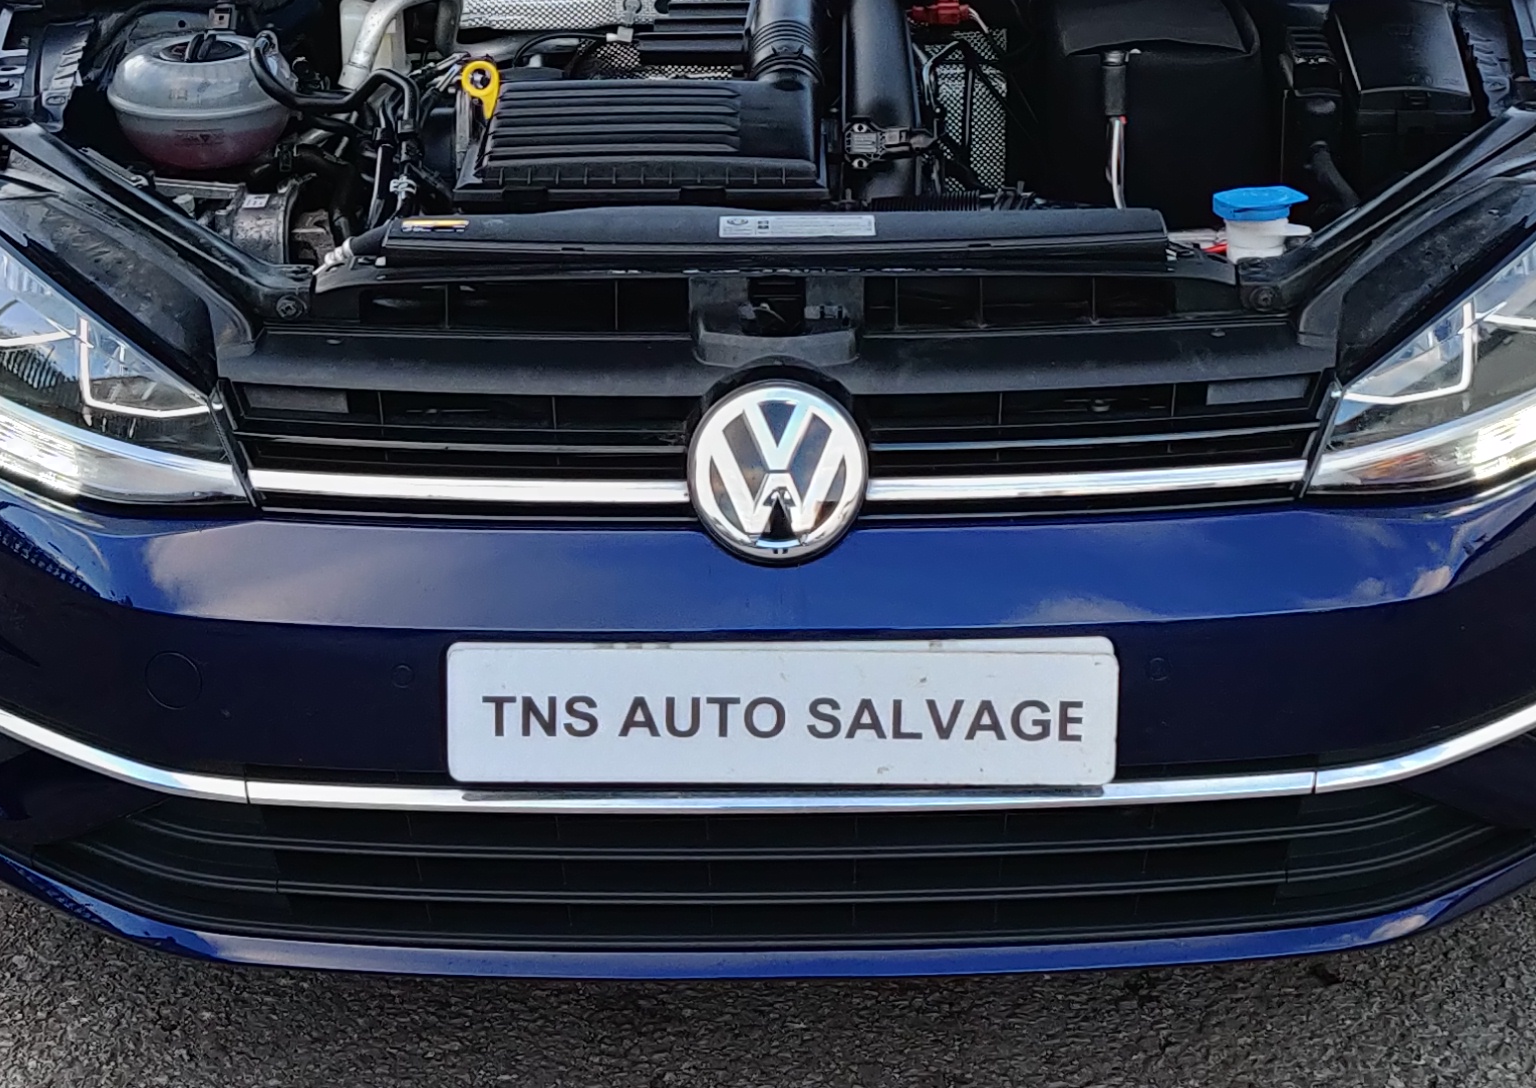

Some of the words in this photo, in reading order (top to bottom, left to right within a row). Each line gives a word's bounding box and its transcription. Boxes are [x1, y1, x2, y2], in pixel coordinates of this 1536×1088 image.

[481, 695, 599, 737] TNS
[617, 696, 787, 738] AUTO
[806, 697, 1084, 742] SALVAGE
